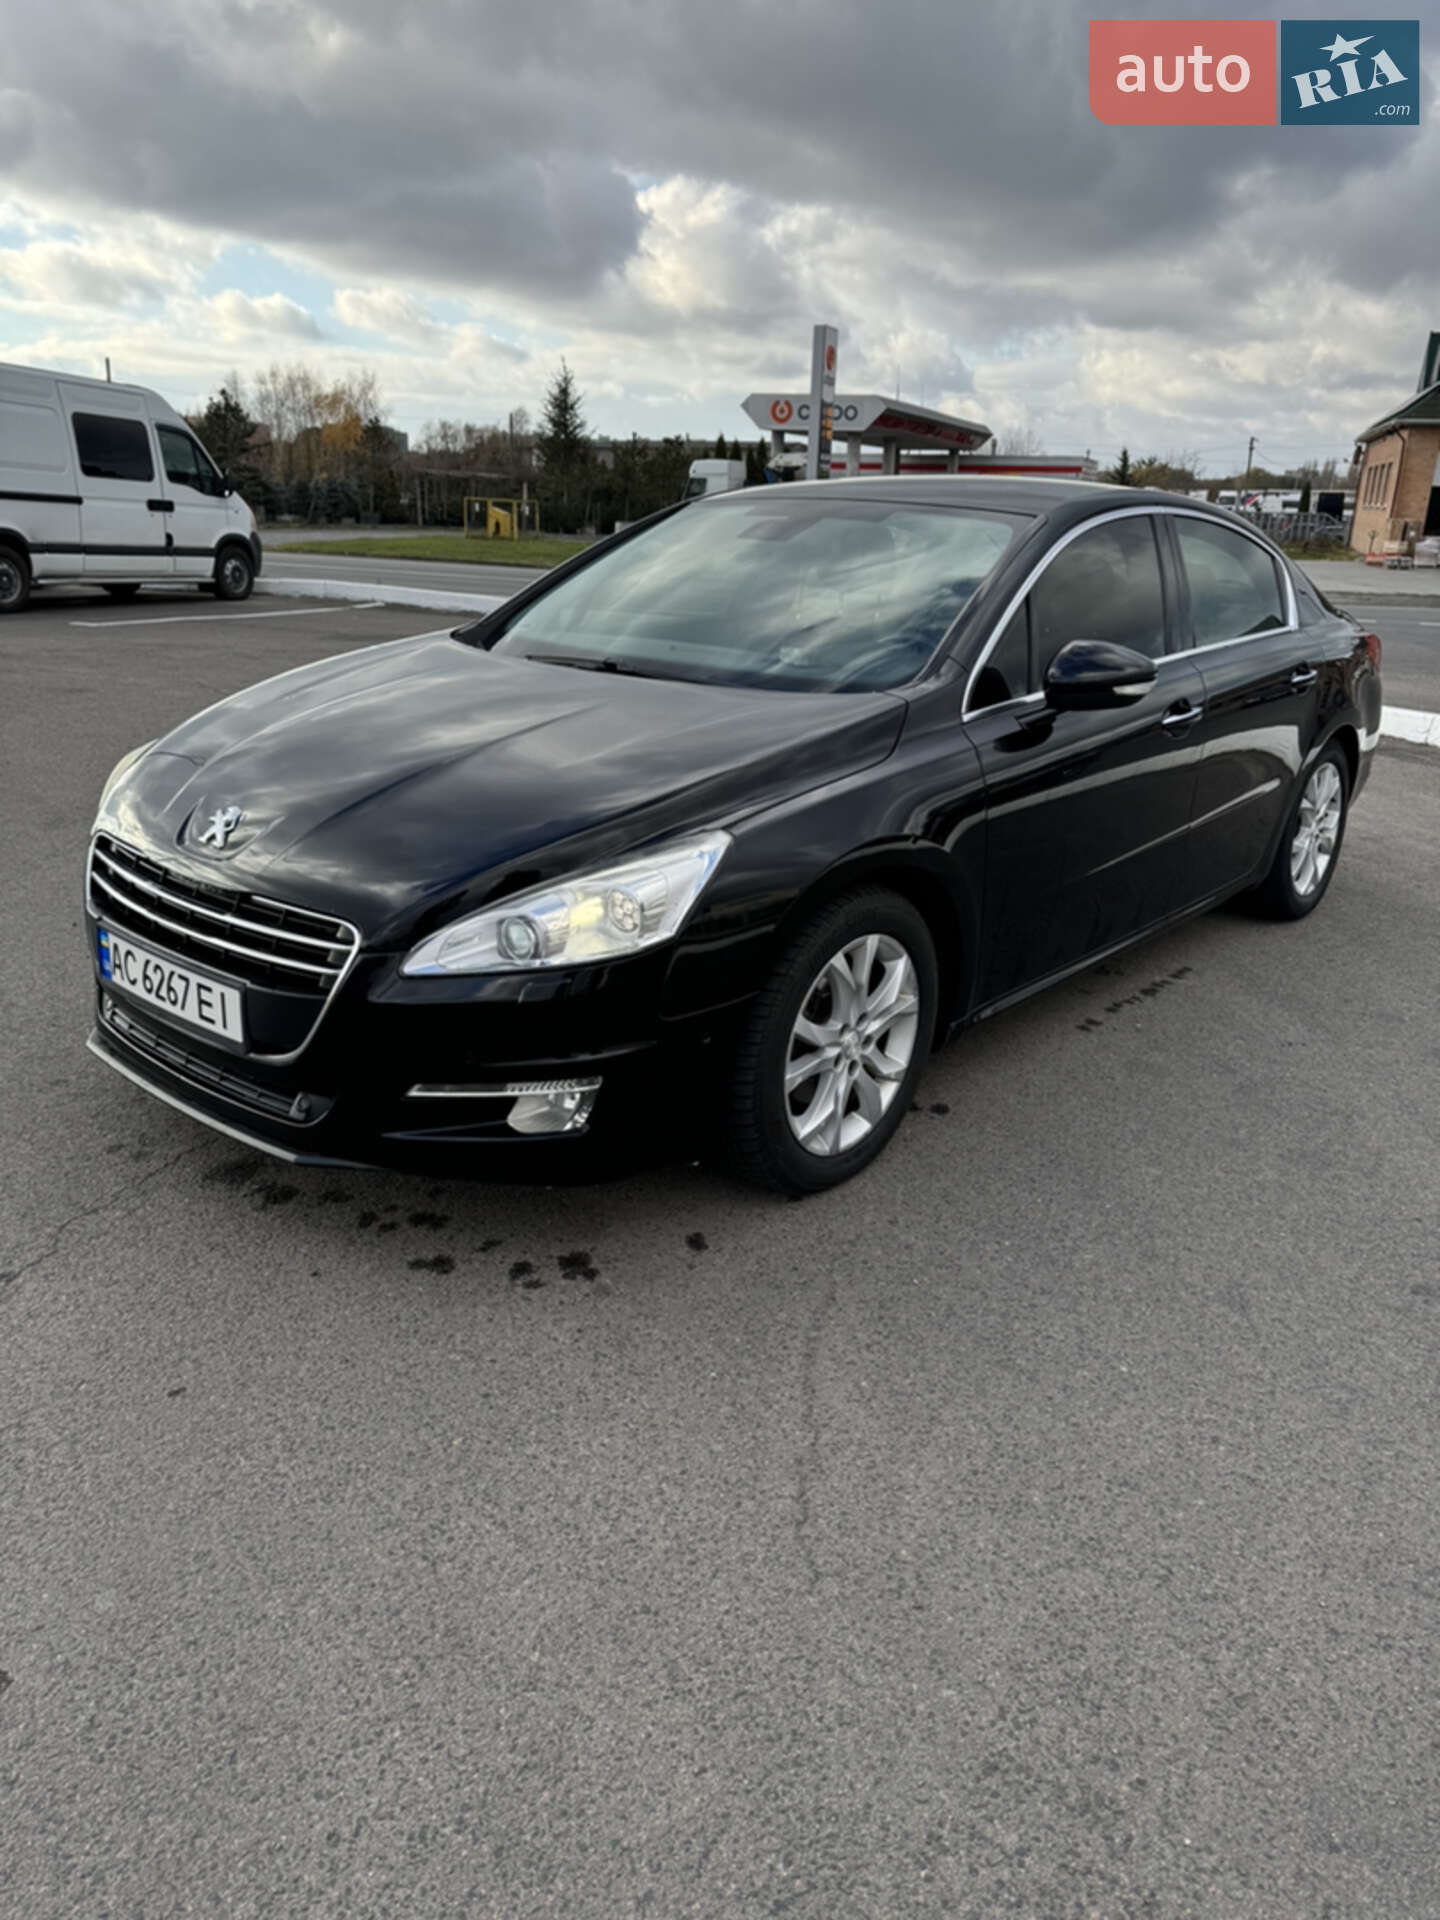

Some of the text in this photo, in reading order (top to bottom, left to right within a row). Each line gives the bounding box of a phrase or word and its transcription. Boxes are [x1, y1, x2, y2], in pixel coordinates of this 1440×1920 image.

[112, 943, 228, 1030] AC 6267 EI
